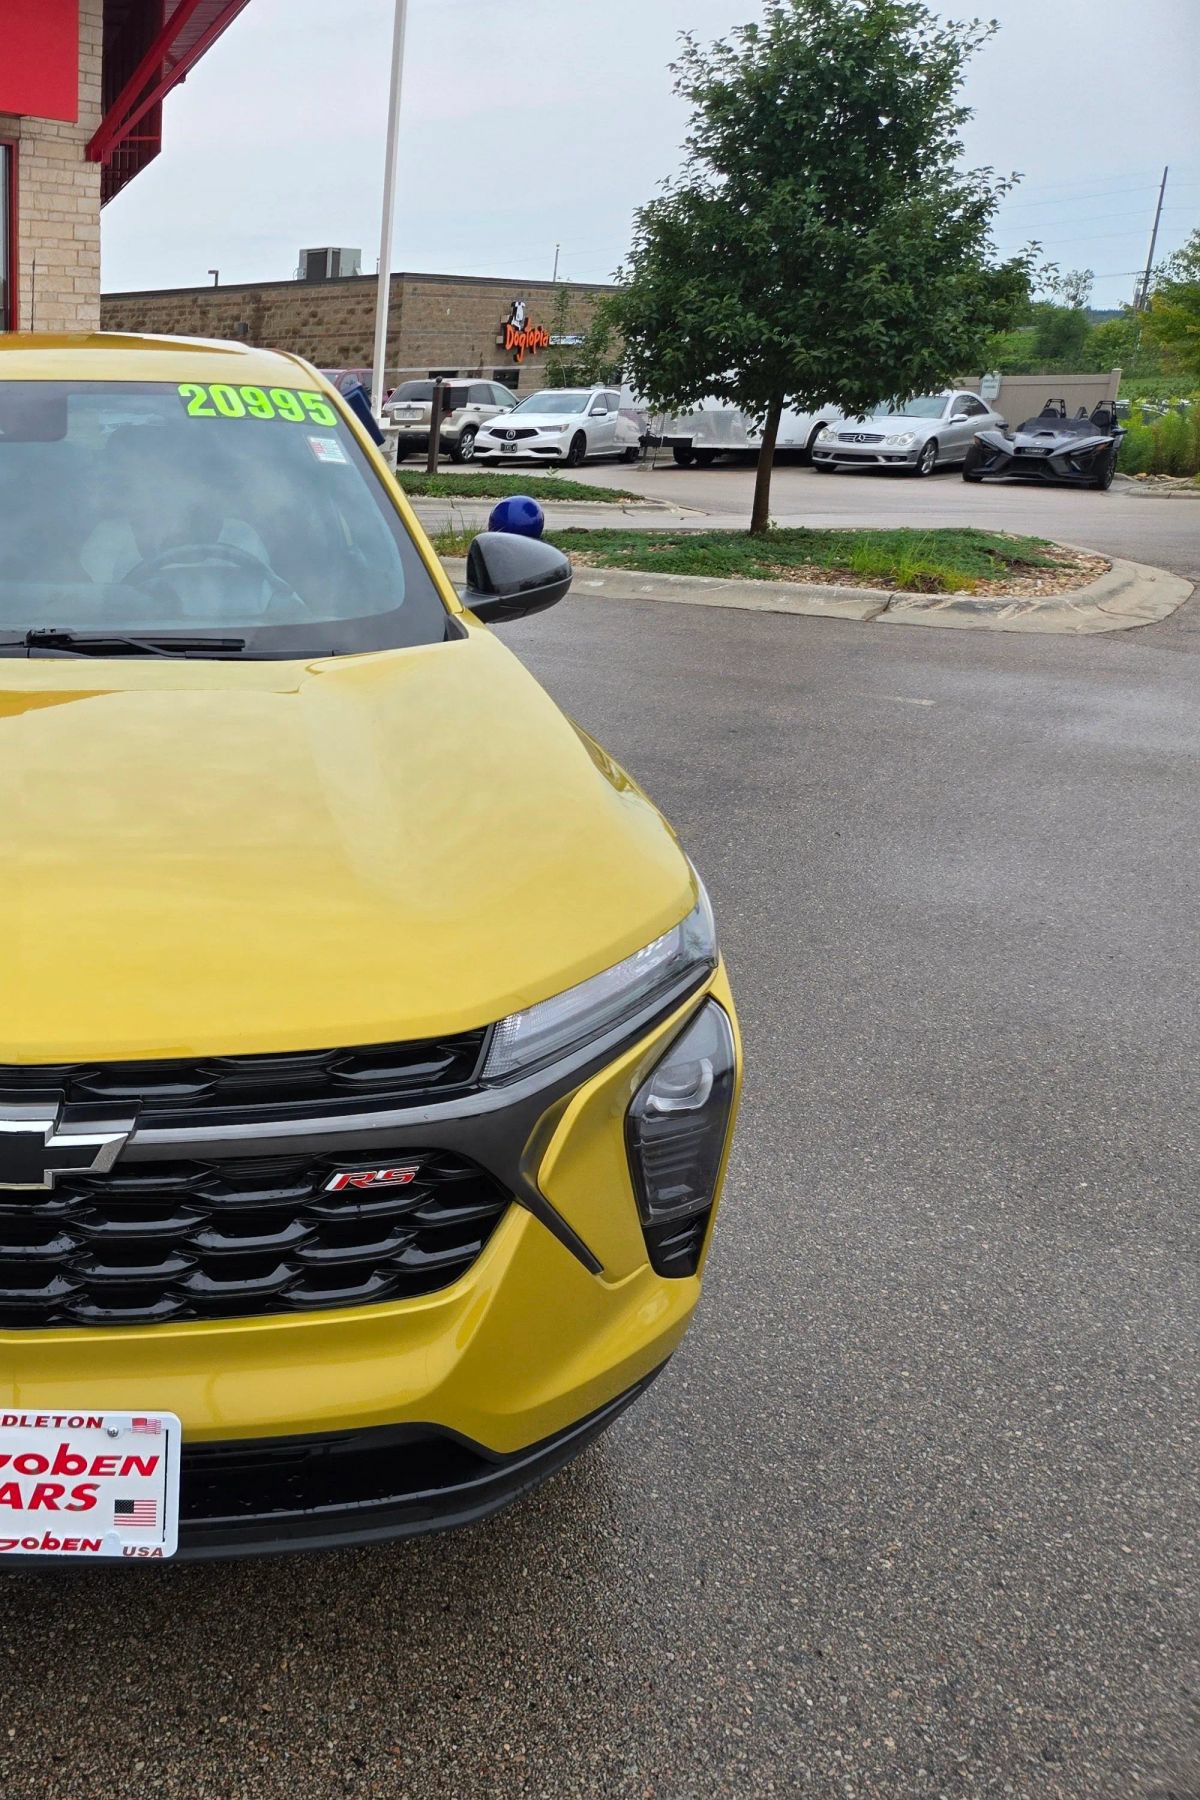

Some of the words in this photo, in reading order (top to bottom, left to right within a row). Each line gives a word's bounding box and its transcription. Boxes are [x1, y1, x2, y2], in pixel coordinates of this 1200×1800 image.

[177, 383, 338, 427] 20995
[325, 1166, 420, 1191] RS
[122, 1545, 164, 1558] USA
